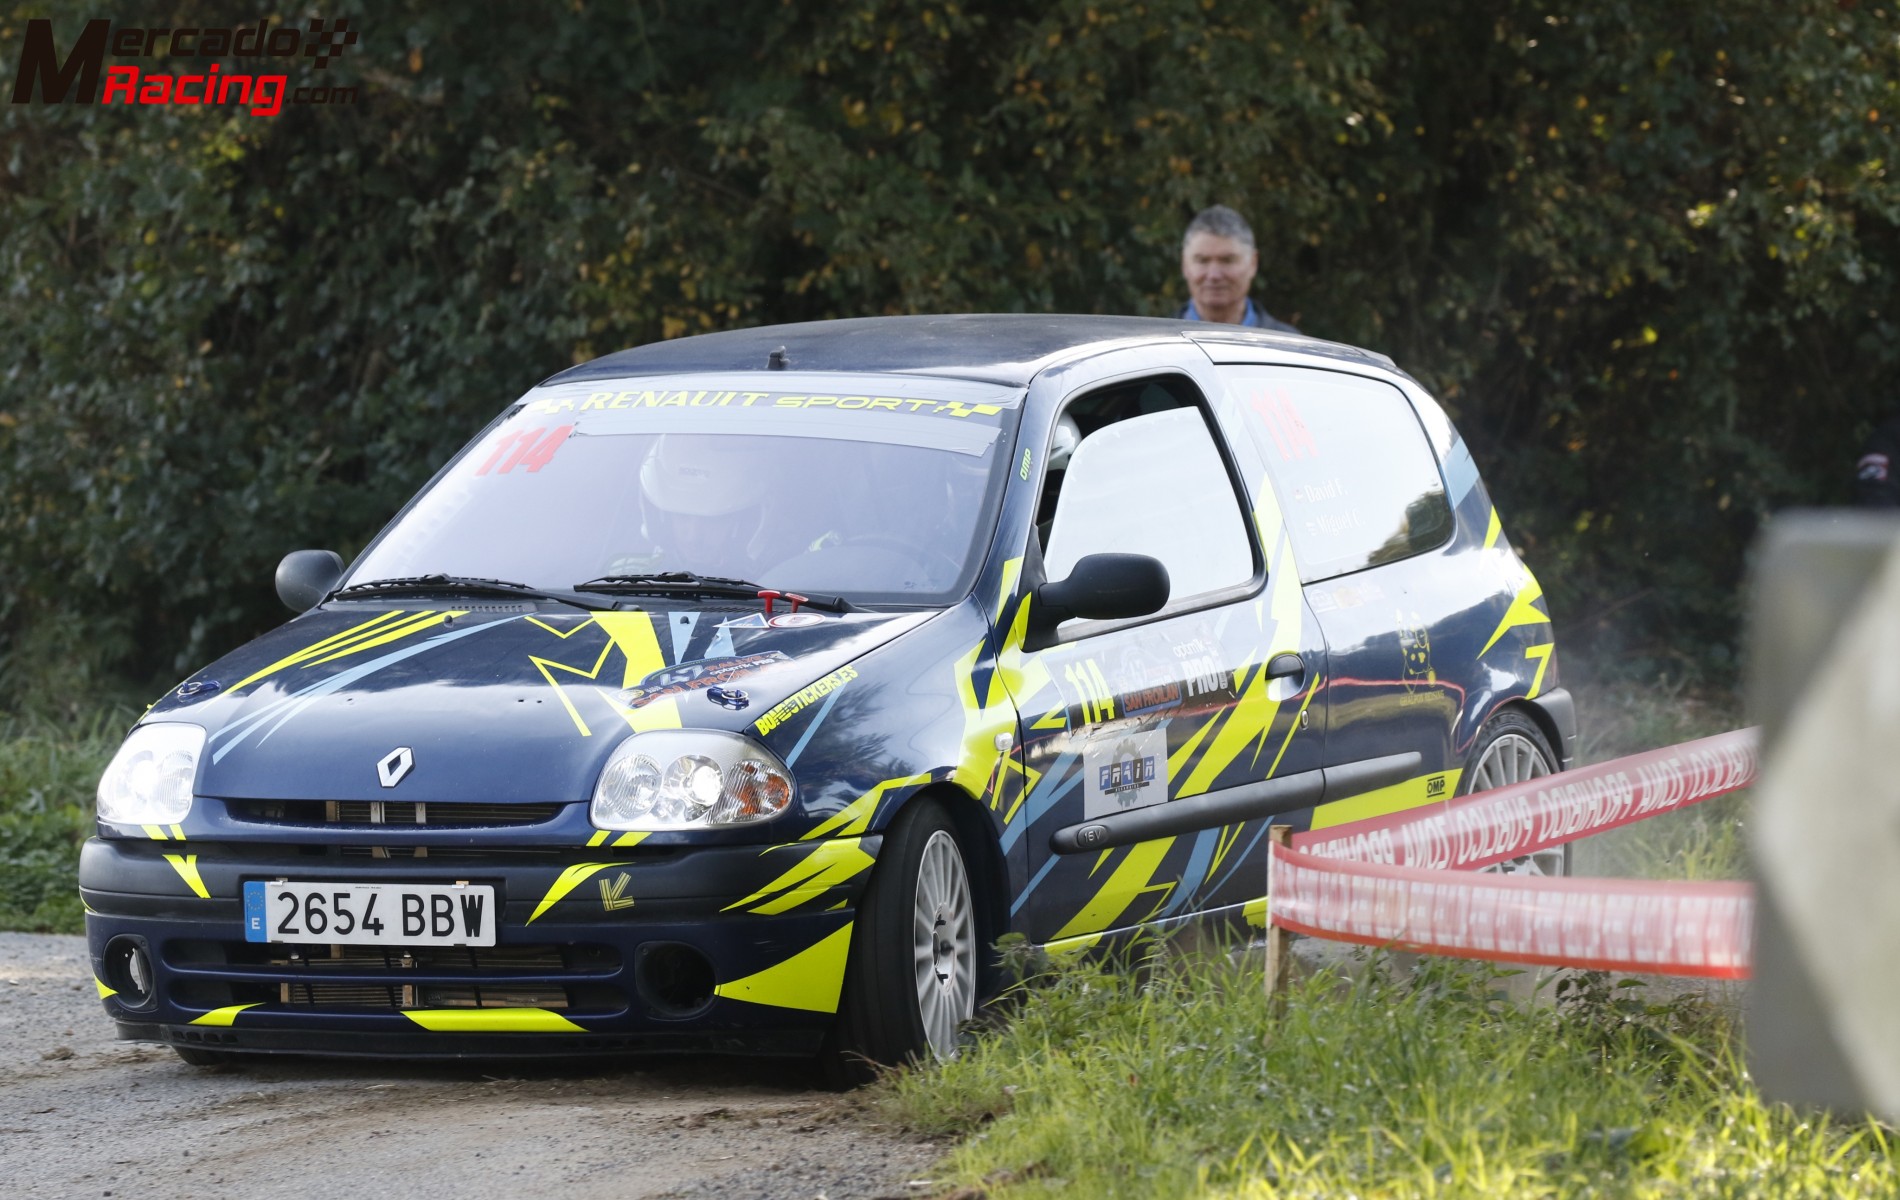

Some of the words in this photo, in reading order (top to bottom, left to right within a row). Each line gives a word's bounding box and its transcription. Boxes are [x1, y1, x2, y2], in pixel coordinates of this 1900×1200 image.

[579, 390, 770, 411] RENAULT
[772, 396, 938, 412] SPORT
[475, 424, 576, 476] 114
[1020, 447, 1031, 481] OMP
[1065, 658, 1115, 725] 114
[1181, 654, 1220, 698] PRO
[1427, 778, 1445, 793] OMP
[1084, 830, 1102, 843] 16V
[251, 917, 261, 930] E
[277, 891, 385, 936] 2654
[401, 893, 484, 938] BBW
